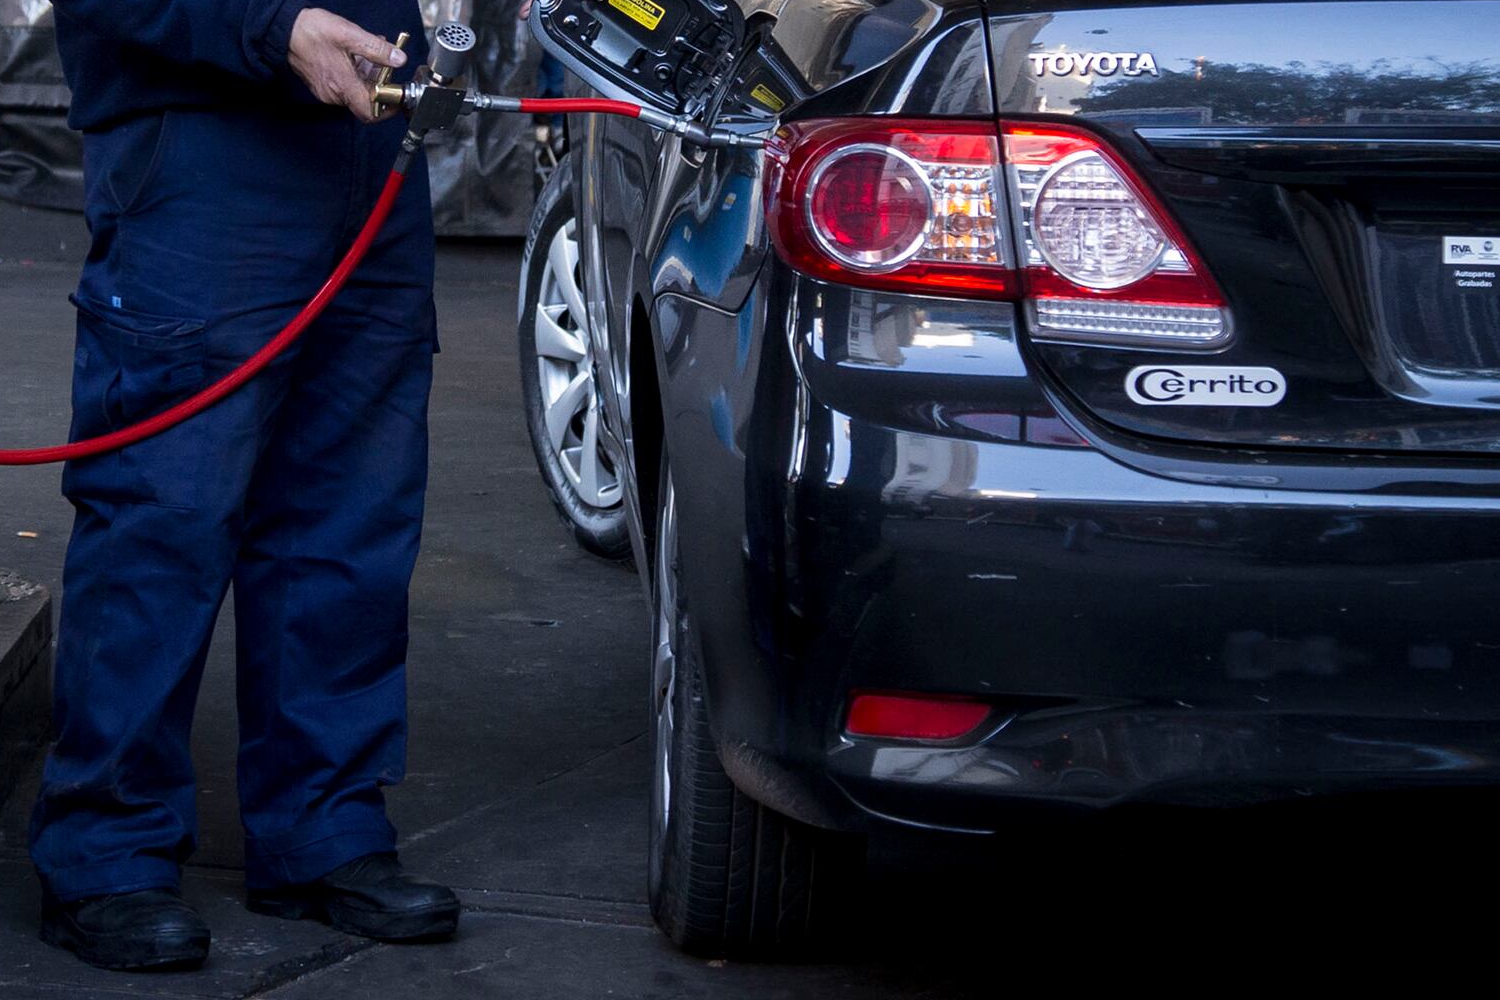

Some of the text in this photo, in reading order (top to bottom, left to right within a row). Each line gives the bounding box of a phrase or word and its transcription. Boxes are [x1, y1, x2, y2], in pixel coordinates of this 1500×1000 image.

[1028, 52, 1159, 76] TOYOTA
[1451, 245, 1472, 253] RVA
[1455, 270, 1496, 279] Autopartes
[1458, 279, 1493, 288] Grabadas
[1134, 368, 1279, 402] Cerrito
